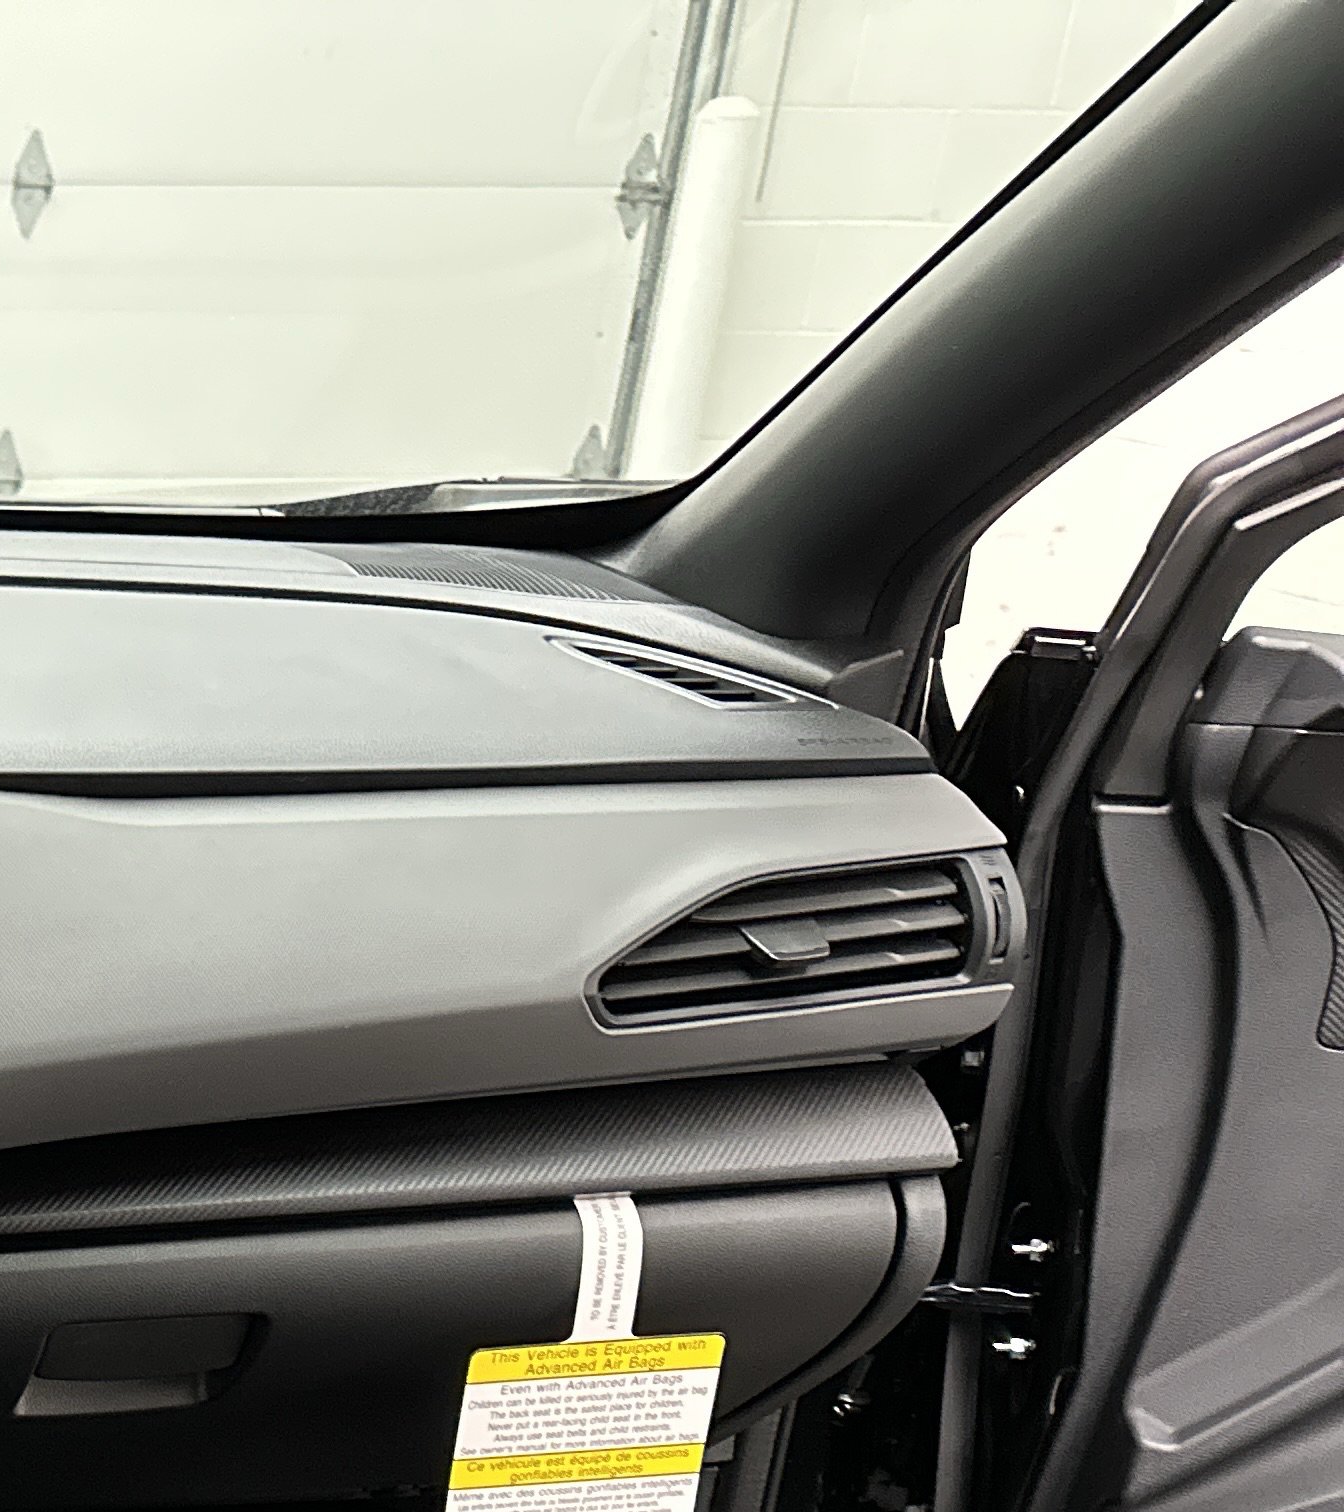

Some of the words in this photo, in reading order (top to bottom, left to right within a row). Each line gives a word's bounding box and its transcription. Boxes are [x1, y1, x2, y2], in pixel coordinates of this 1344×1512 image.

[599, 1245, 607, 1255] BY
[618, 1241, 626, 1251] LE
[594, 1258, 606, 1295] REMOVED
[592, 1298, 601, 1308] BE
[590, 1310, 600, 1320] TO
[490, 1351, 520, 1363] This
[527, 1347, 579, 1360] Vehicle
[585, 1346, 597, 1356] is
[603, 1340, 671, 1357] Equipped
[677, 1339, 706, 1350] with
[525, 1360, 596, 1375] Advanced
[603, 1357, 623, 1369] Air
[628, 1354, 665, 1371] Bags
[500, 1383, 531, 1394] Even
[536, 1382, 560, 1391] with
[566, 1377, 625, 1389] Advanced
[630, 1376, 647, 1385] Air
[652, 1373, 683, 1386] Bags
[468, 1398, 503, 1409] Children
[525, 1397, 536, 1405] be
[539, 1396, 561, 1404] killed
[616, 1390, 644, 1400] injured
[647, 1389, 657, 1397] by
[490, 1411, 506, 1419] The
[533, 1408, 550, 1416] seat
[609, 1403, 631, 1411] place
[487, 1422, 512, 1430] Never
[516, 1421, 530, 1430] put
[613, 1414, 630, 1422] seat
[493, 1433, 523, 1443] Always
[567, 1429, 586, 1437] belts
[460, 1447, 476, 1455] See
[516, 1443, 546, 1451] manual
[466, 1461, 484, 1471] Ce
[546, 1457, 565, 1466] est
[615, 1452, 631, 1461] de
[636, 1449, 689, 1460] coussins
[577, 1463, 643, 1480] intelligents
[488, 1491, 512, 1499] avec
[538, 1486, 582, 1495] coussins
